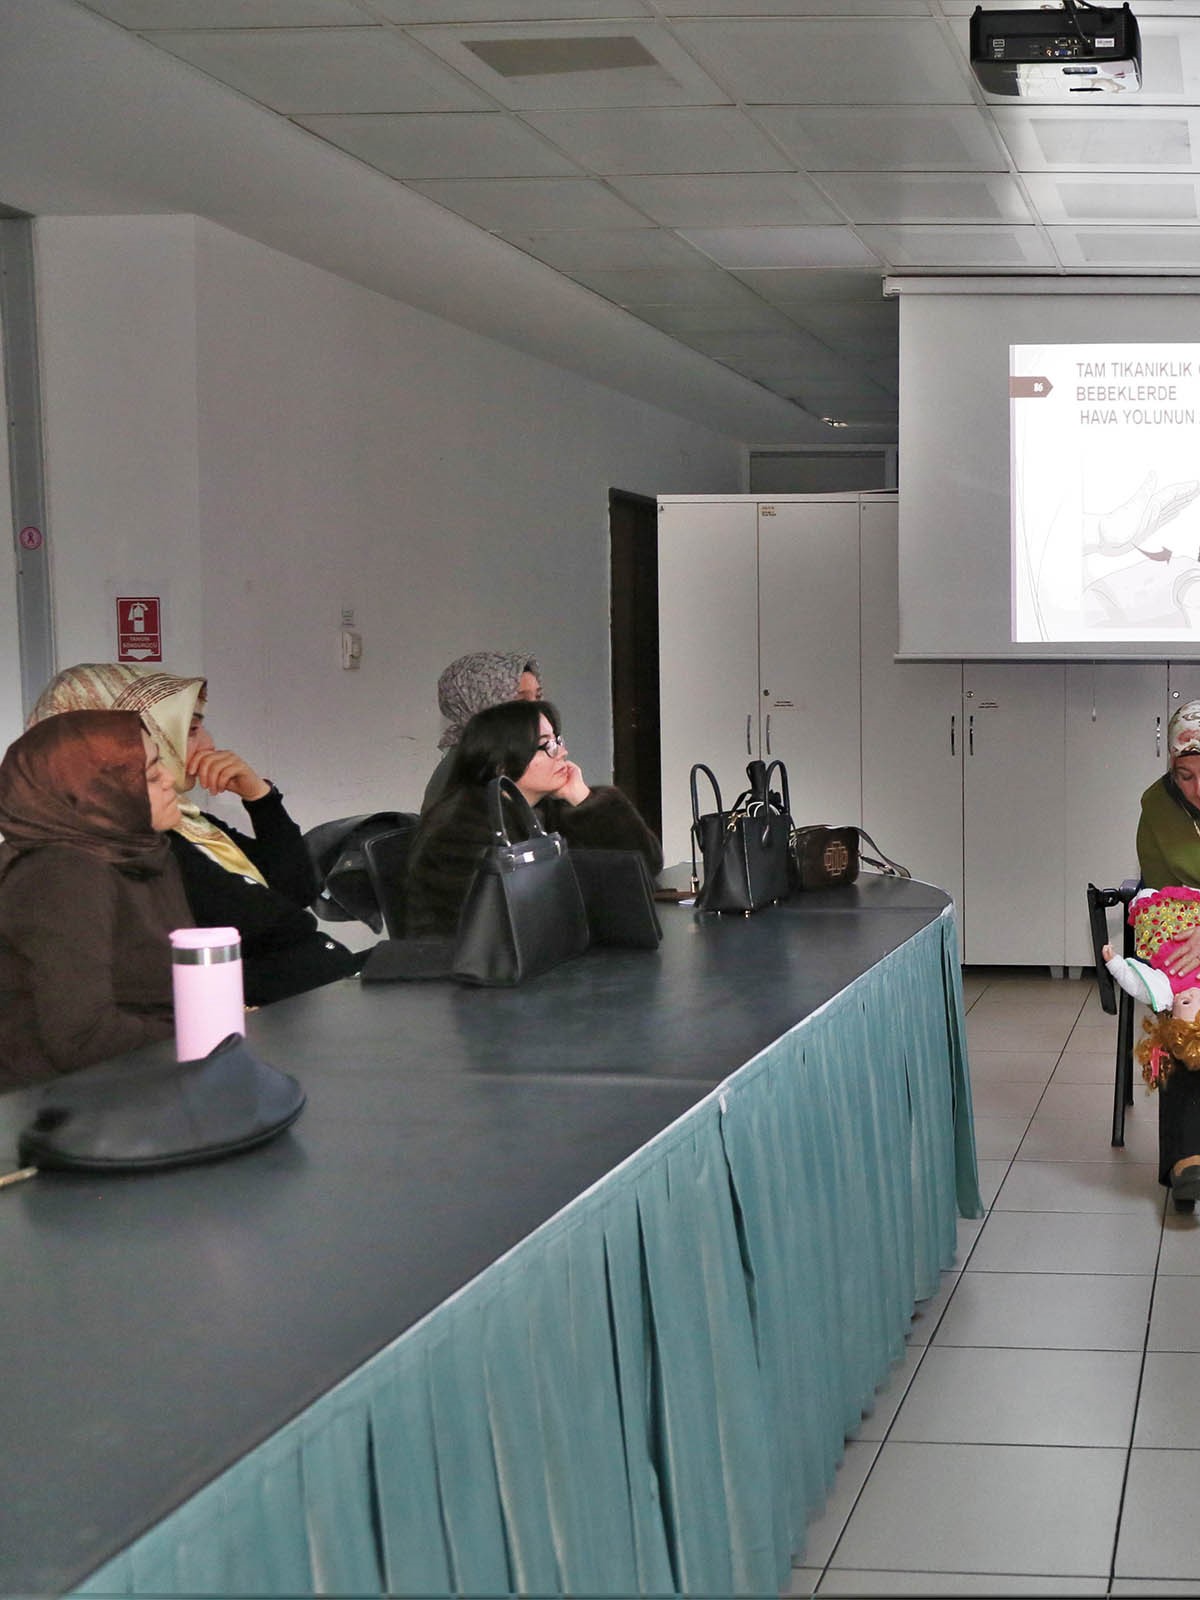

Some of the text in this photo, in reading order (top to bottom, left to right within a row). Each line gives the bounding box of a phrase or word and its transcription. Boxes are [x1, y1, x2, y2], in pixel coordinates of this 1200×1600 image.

[1076, 362, 1106, 377] TAM
[1111, 361, 1193, 377] TIKANIKLIK
[1076, 385, 1177, 401] BEBEKLERDE
[1080, 409, 1118, 425] HAVA
[1122, 409, 1195, 425] YOLUNUN
